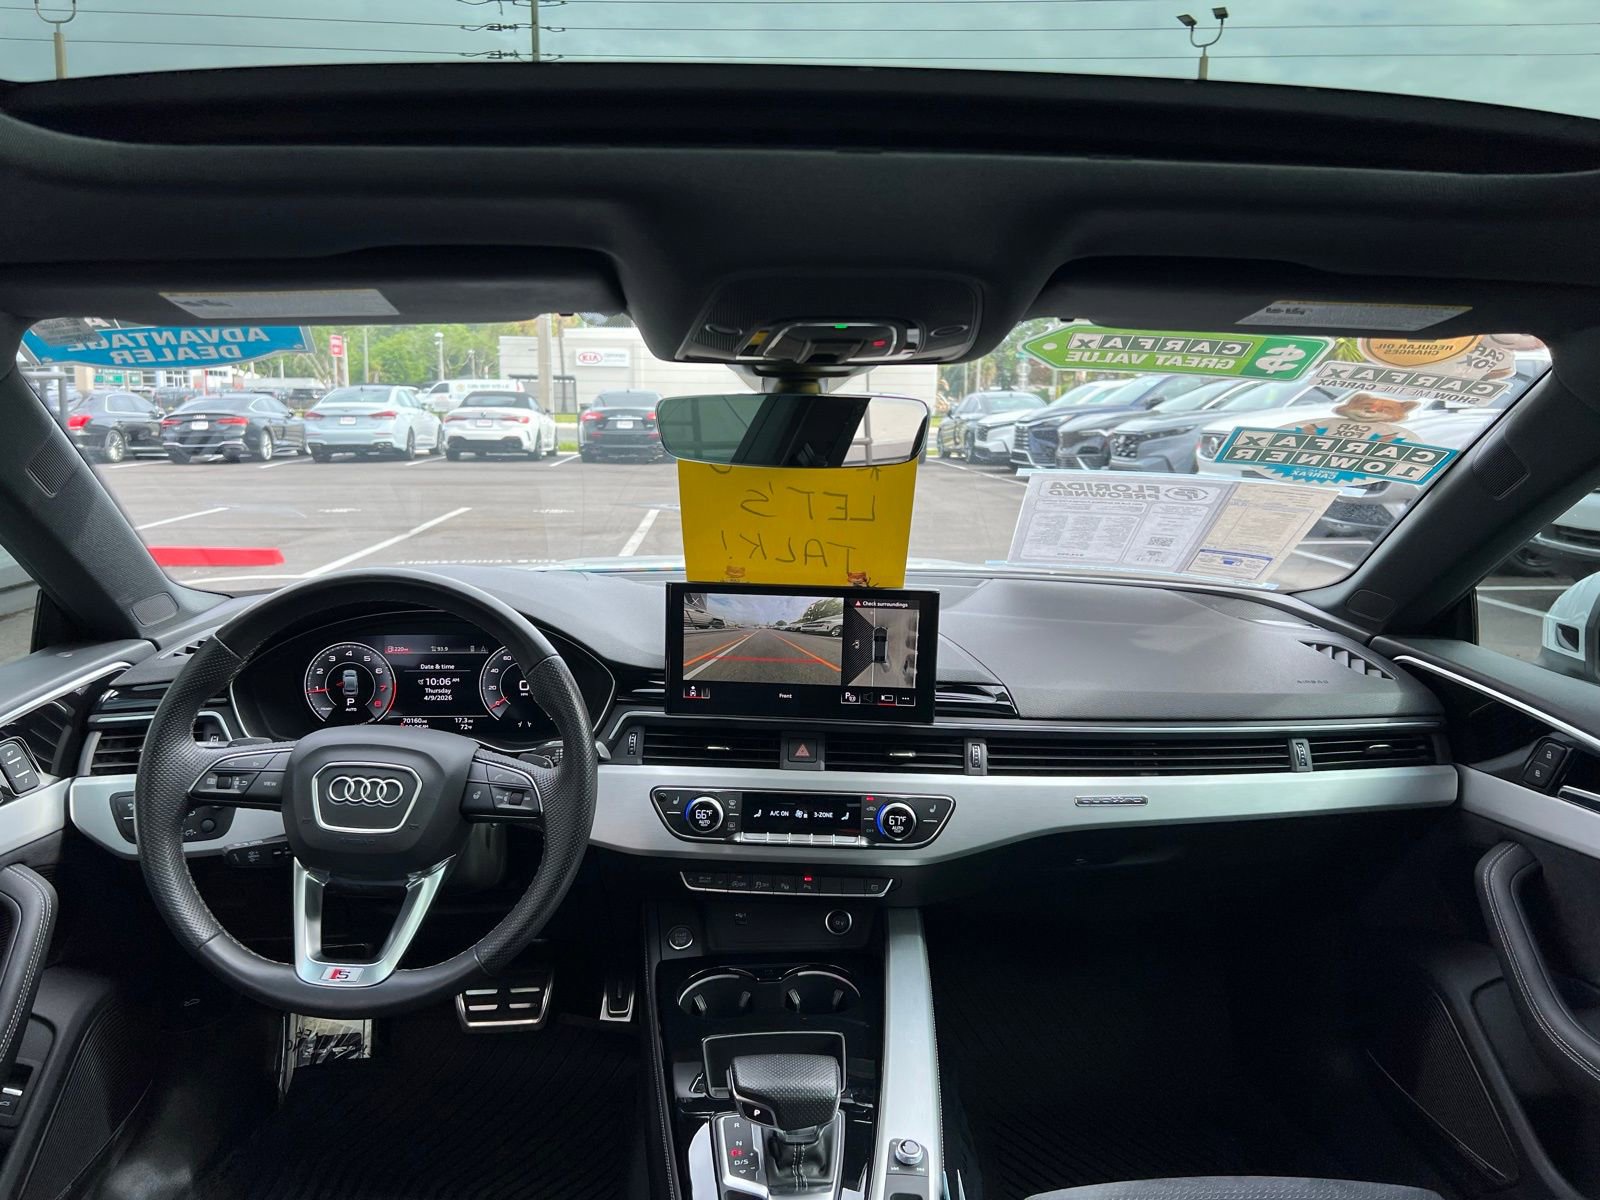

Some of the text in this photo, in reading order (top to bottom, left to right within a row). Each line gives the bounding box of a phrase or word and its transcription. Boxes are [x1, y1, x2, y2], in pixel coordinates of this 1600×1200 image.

[425, 677, 452, 686] 10:06
[518, 680, 530, 691] 0
[380, 684, 387, 692] 7
[424, 687, 452, 695] Thursday
[346, 697, 355, 706] P
[374, 700, 382, 708] 8
[753, 1109, 761, 1117] P
[734, 1158, 749, 1166] D/S
